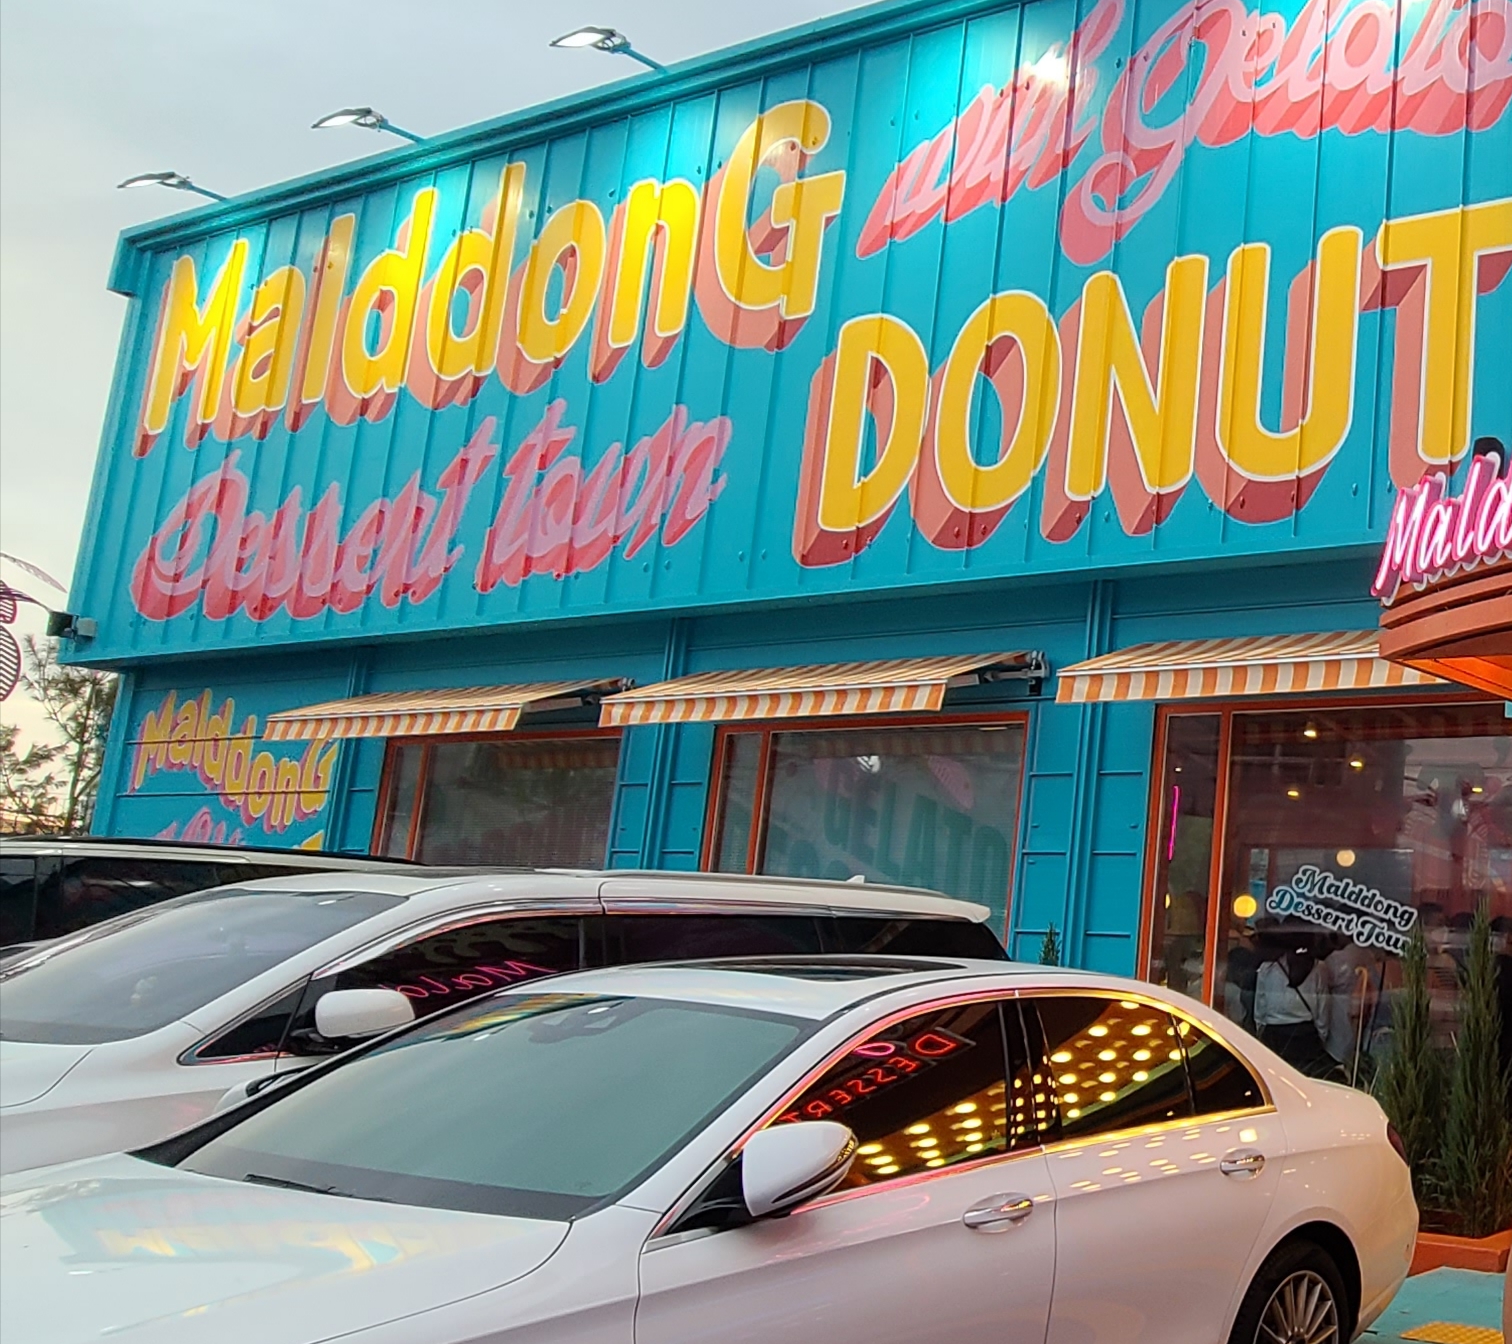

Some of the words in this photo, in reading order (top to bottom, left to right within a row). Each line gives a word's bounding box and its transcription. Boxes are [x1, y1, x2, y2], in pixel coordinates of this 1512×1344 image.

[138, 100, 846, 446] MalddonG
[134, 416, 497, 614] Dessert
[1266, 886, 1357, 935] Dessert
[1292, 865, 1417, 931] Malddong
